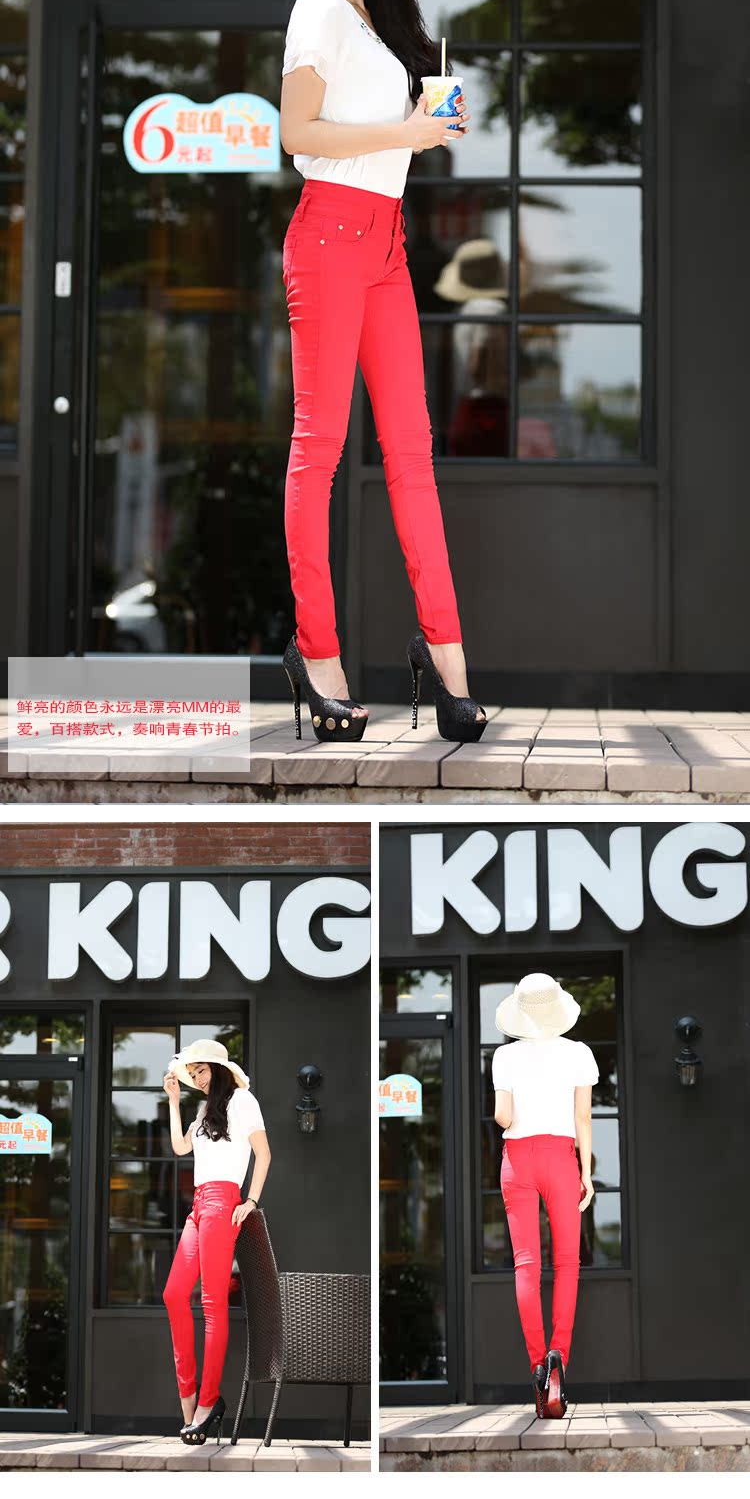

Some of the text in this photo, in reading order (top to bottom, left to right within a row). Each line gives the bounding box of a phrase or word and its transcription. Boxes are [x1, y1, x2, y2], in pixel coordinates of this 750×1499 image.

[133, 100, 174, 163] 6
[48, 876, 371, 982] KING
[411, 823, 746, 935] KING
